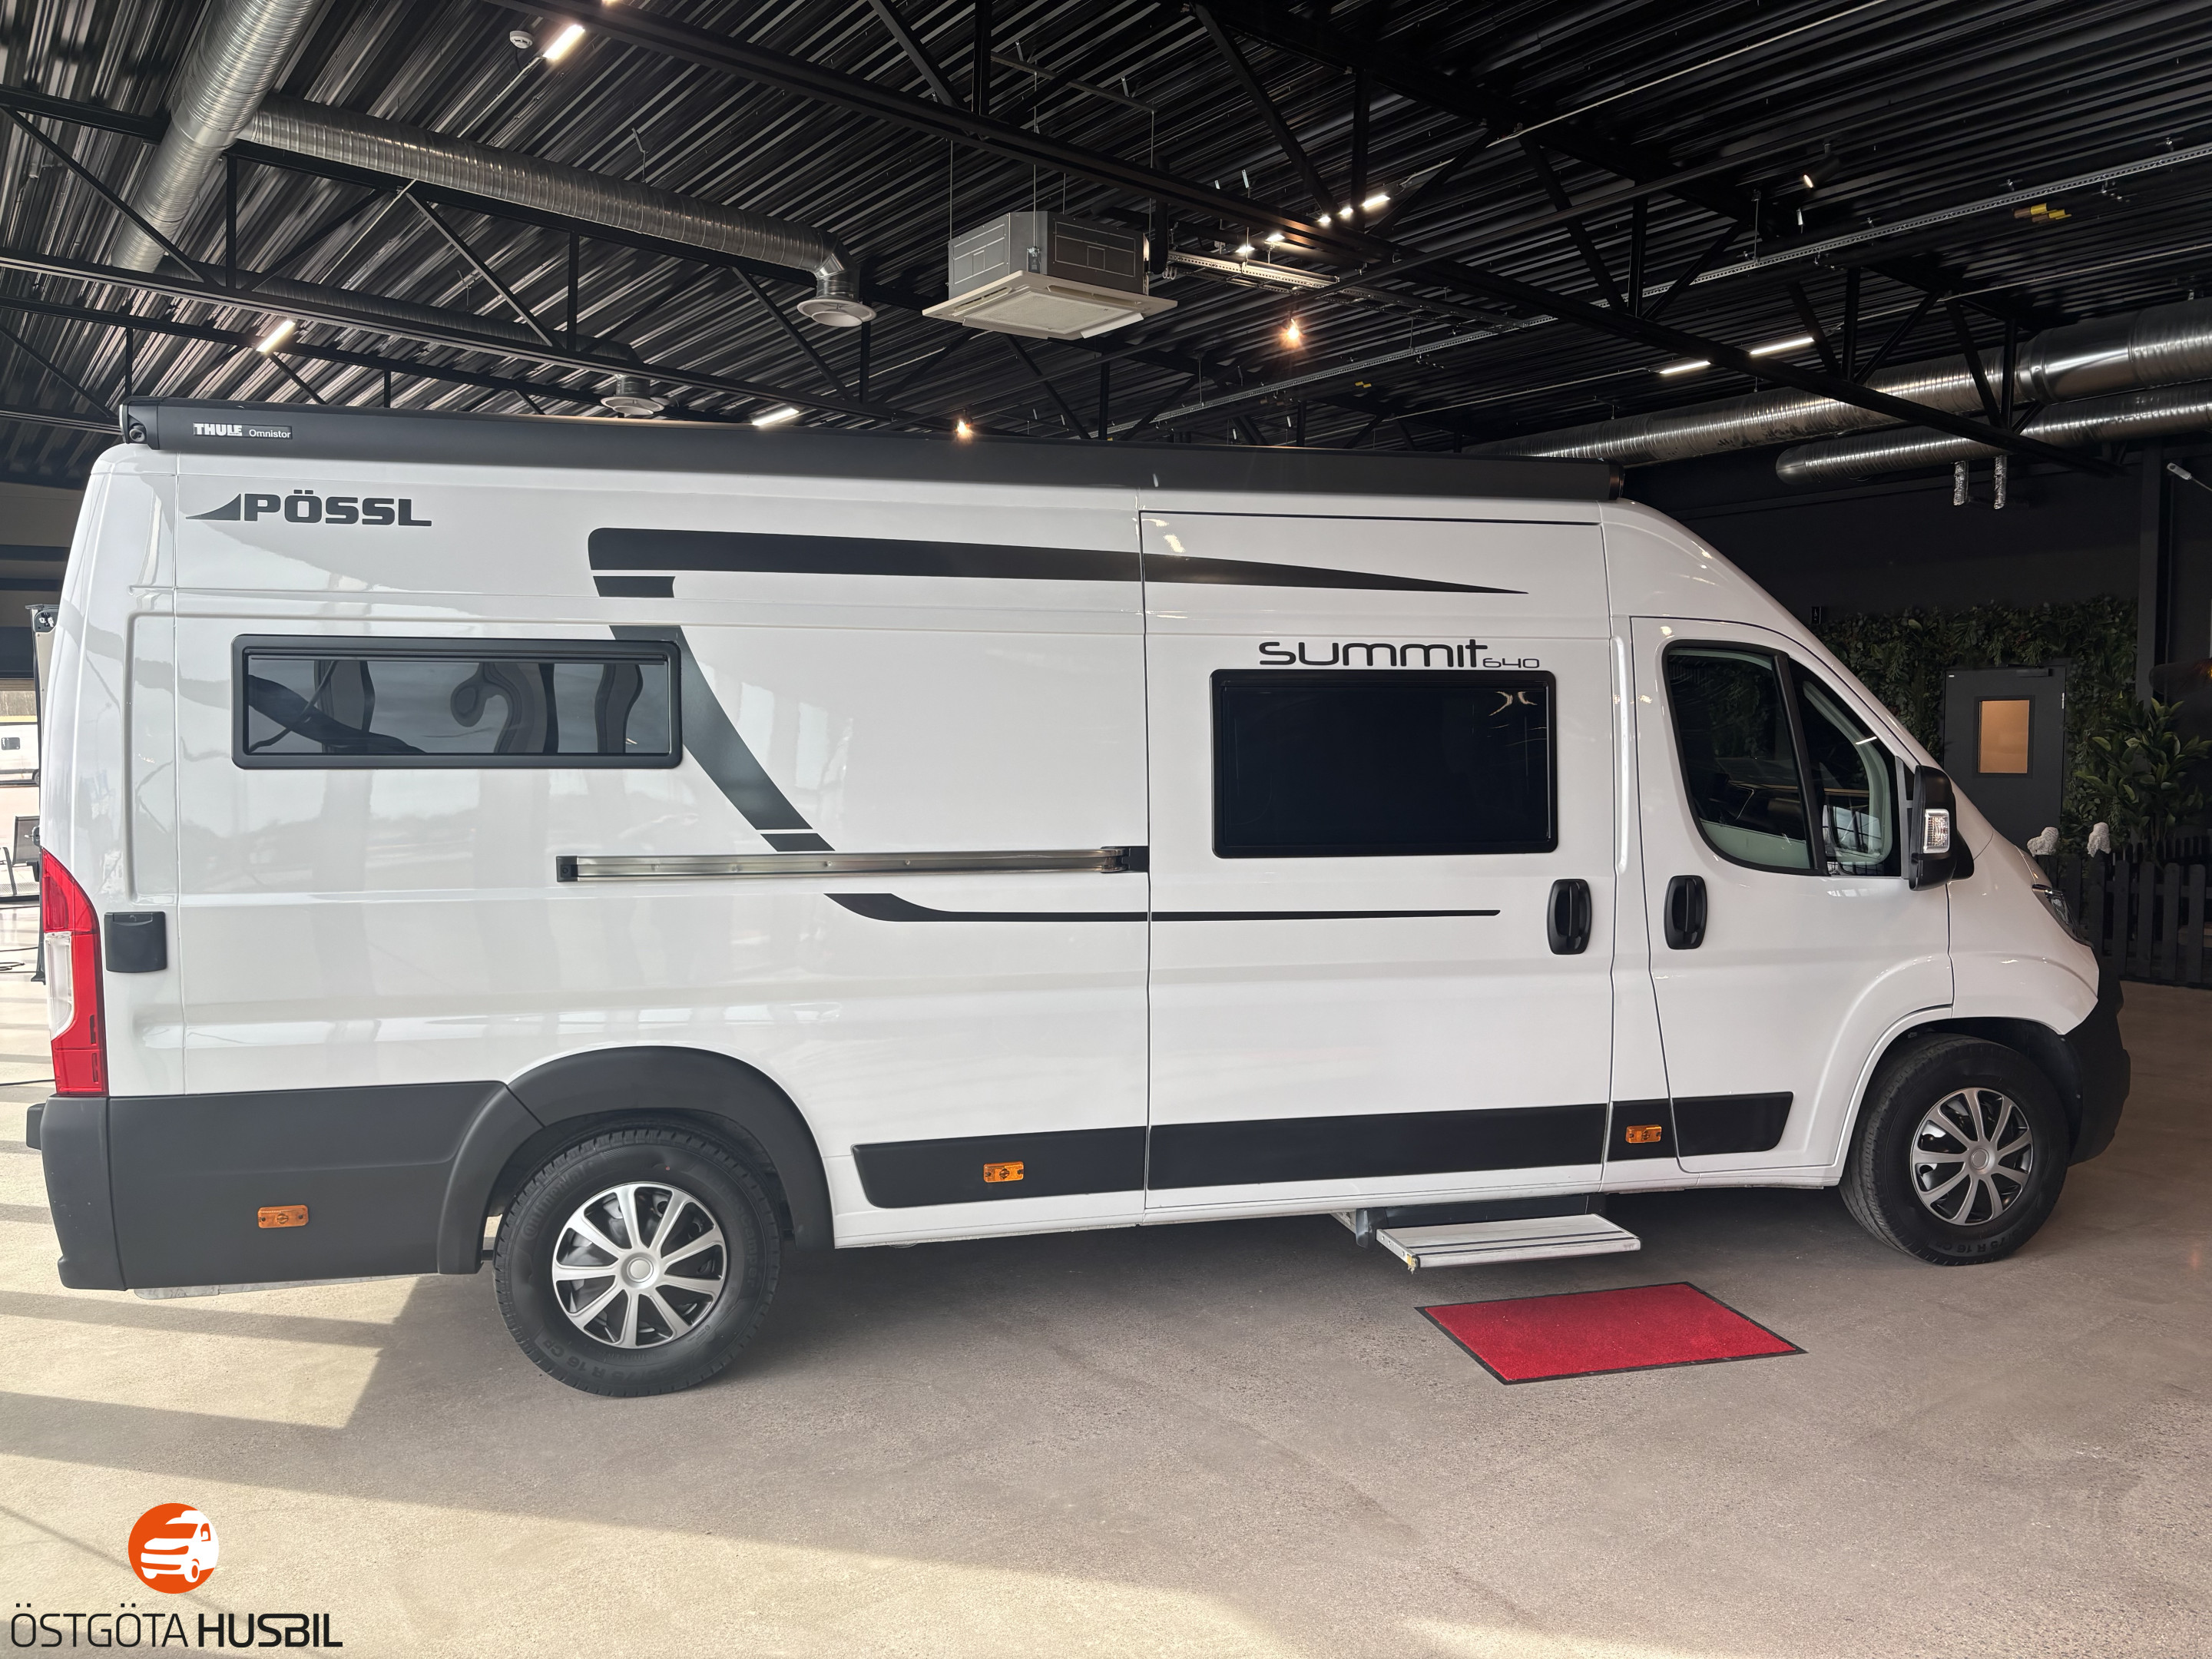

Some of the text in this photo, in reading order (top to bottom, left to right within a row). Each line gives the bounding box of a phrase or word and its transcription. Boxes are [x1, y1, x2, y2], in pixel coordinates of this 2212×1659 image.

[194, 423, 291, 439] THULE Omnistor
[243, 489, 432, 527] PÖSSL
[1259, 639, 1540, 669] summit 640
